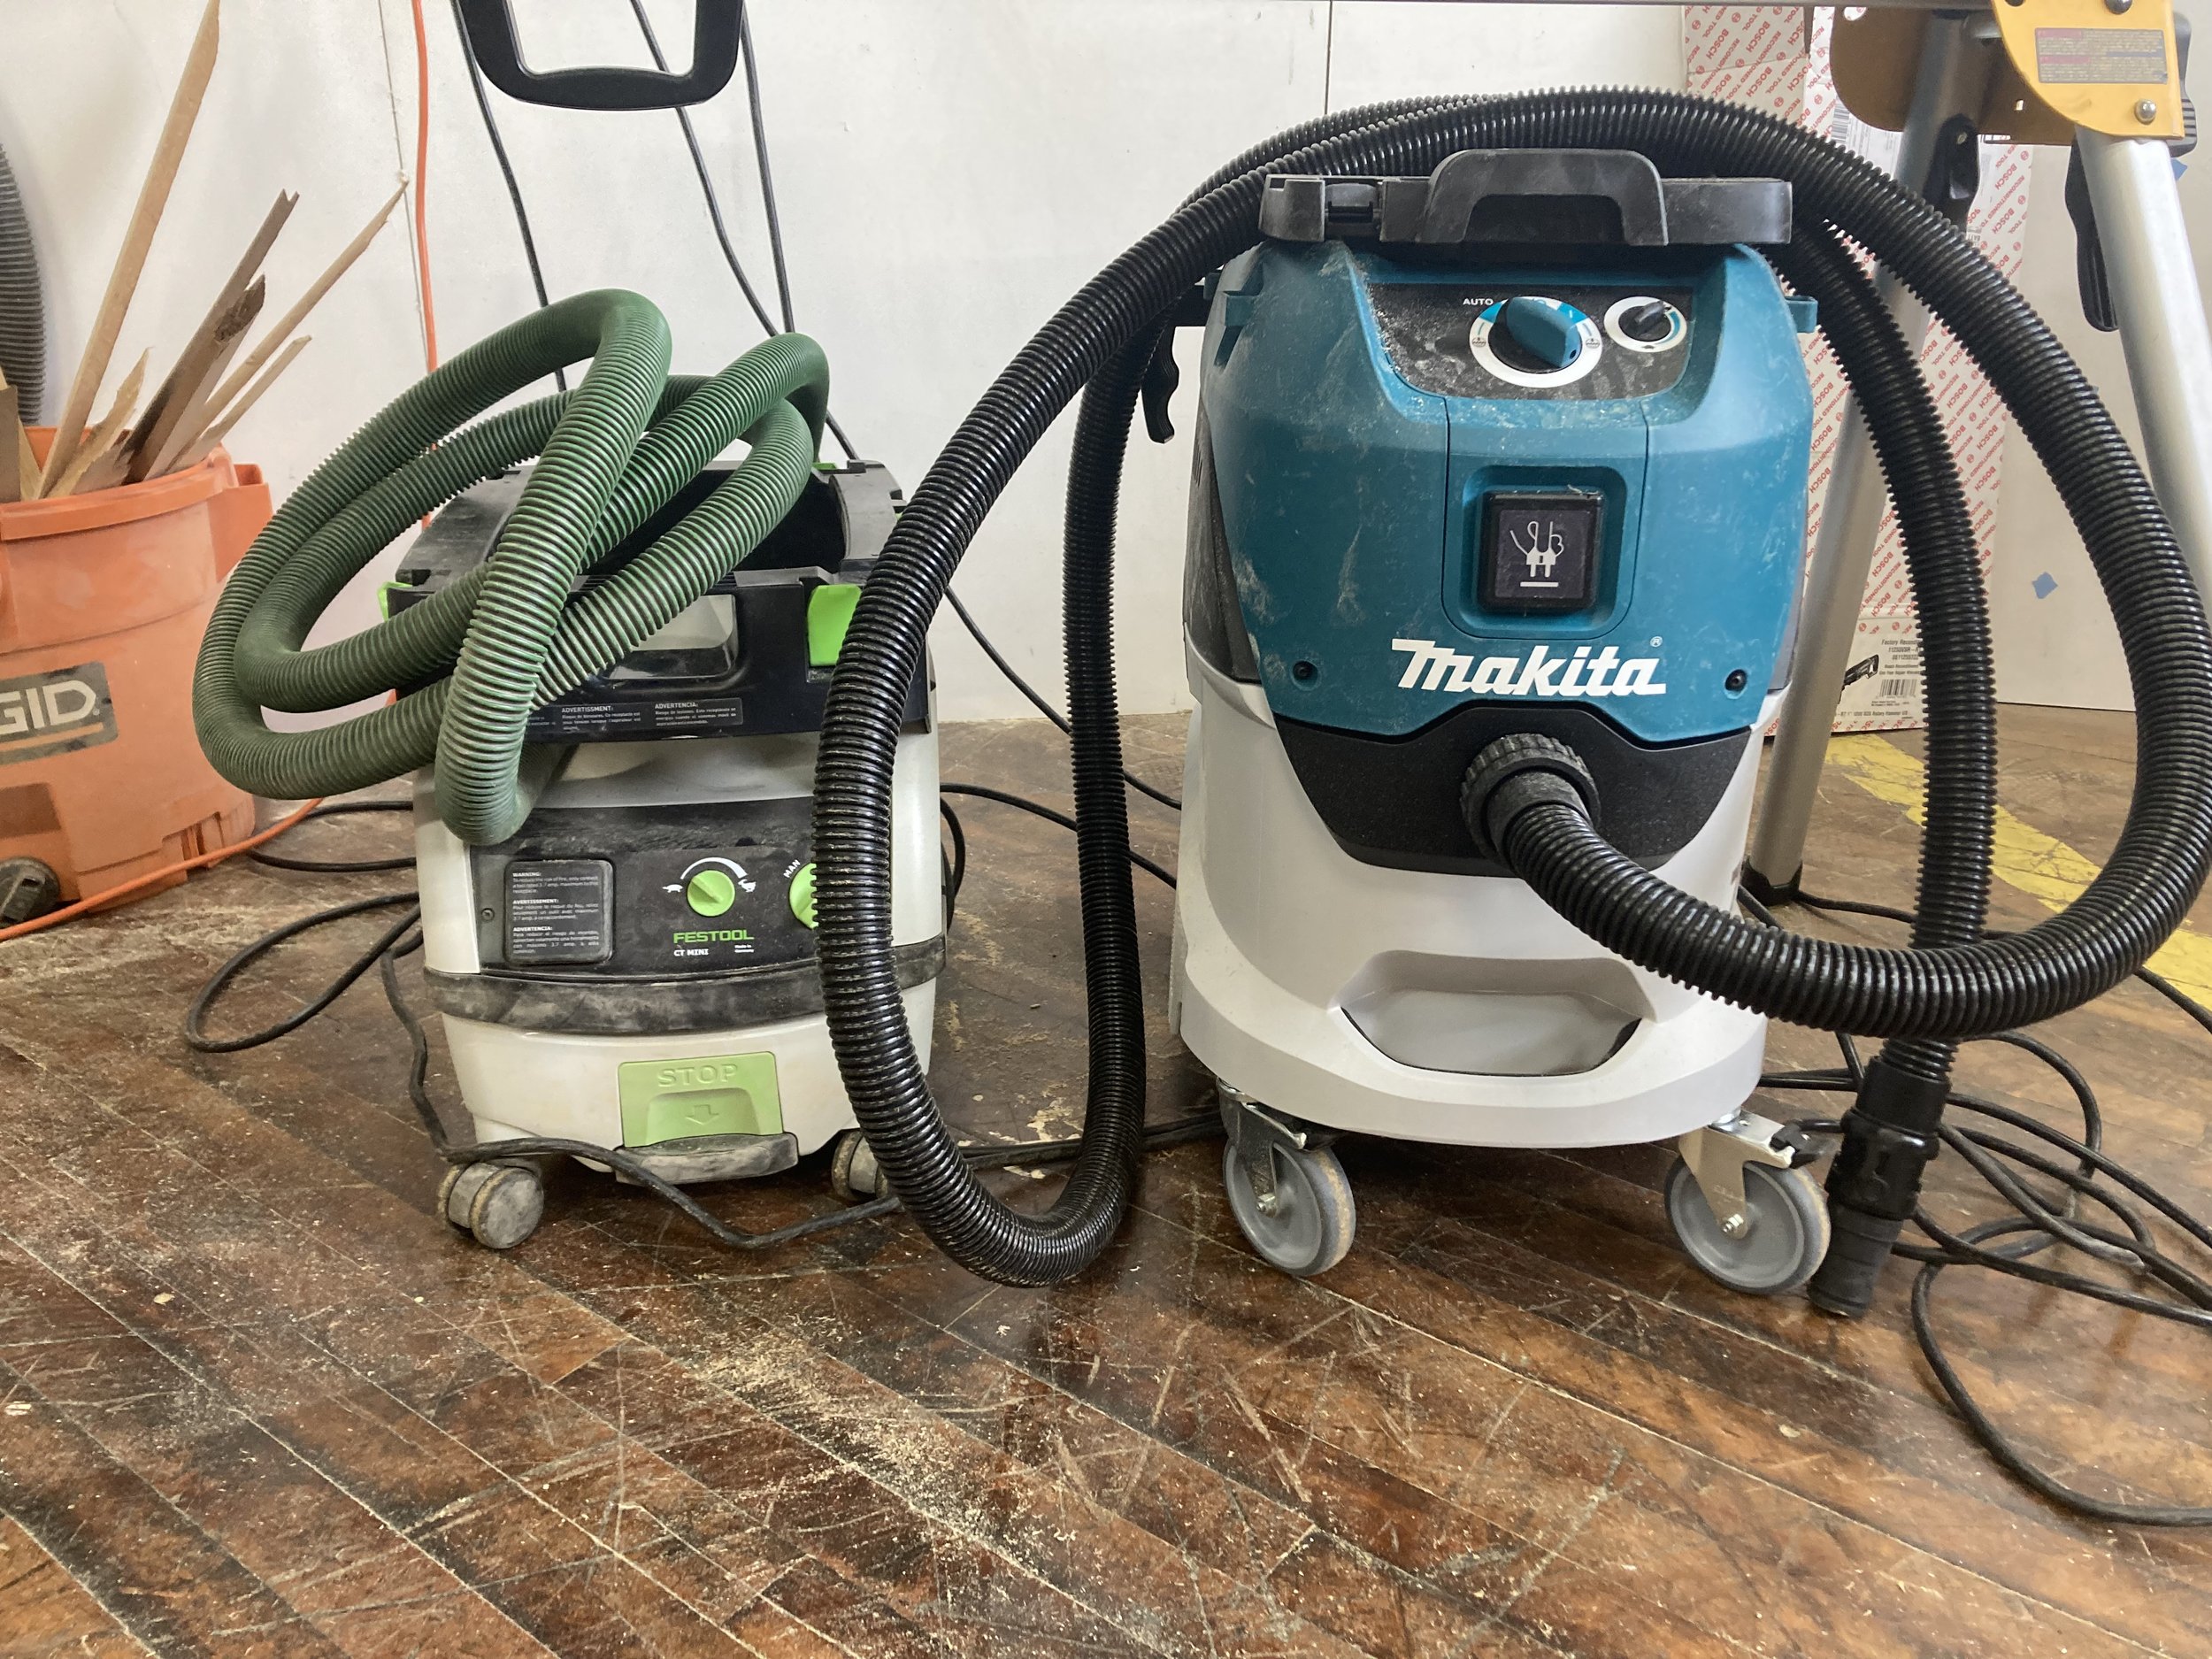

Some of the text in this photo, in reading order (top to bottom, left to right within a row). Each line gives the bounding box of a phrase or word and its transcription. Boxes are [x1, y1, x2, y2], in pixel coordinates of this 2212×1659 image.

[1702, 21, 1717, 38] TOOL
[1743, 14, 1757, 30] TOOL
[1706, 28, 1729, 59] BOSCH
[1746, 21, 1770, 53] BOSCH
[1701, 38, 1740, 89] RECONDITIONED
[1726, 31, 1782, 100] RECONDITIONED TOOL
[1787, 62, 1812, 91] BOSCH
[1712, 73, 1732, 97] BOSC
[1747, 66, 1772, 97] BOSCH
[1765, 77, 1782, 95] TOOL
[1807, 74, 1821, 89] TOOL
[1994, 163, 2017, 190] BOSCH
[1992, 208, 2015, 234] BOSCH
[1463, 297, 1494, 306] AUTO
[1947, 383, 1968, 409] BOSCH
[1948, 425, 1966, 446] BOSC
[1977, 417, 1989, 430] TOOL
[1811, 425, 1833, 451] BOSCH
[1977, 425, 1998, 449] BOSCH
[1809, 467, 1832, 494] BOSCH
[1975, 465, 1996, 492] BOSCH
[1872, 551, 1893, 577] BOSCH
[1865, 562, 1901, 604] RECONDITIONED
[1870, 592, 1892, 618] BOSCH
[1392, 639, 1666, 696] makita
[783, 859, 801, 878] MAN
[673, 929, 754, 943] FESTOOL
[657, 1064, 738, 1087] STOP
